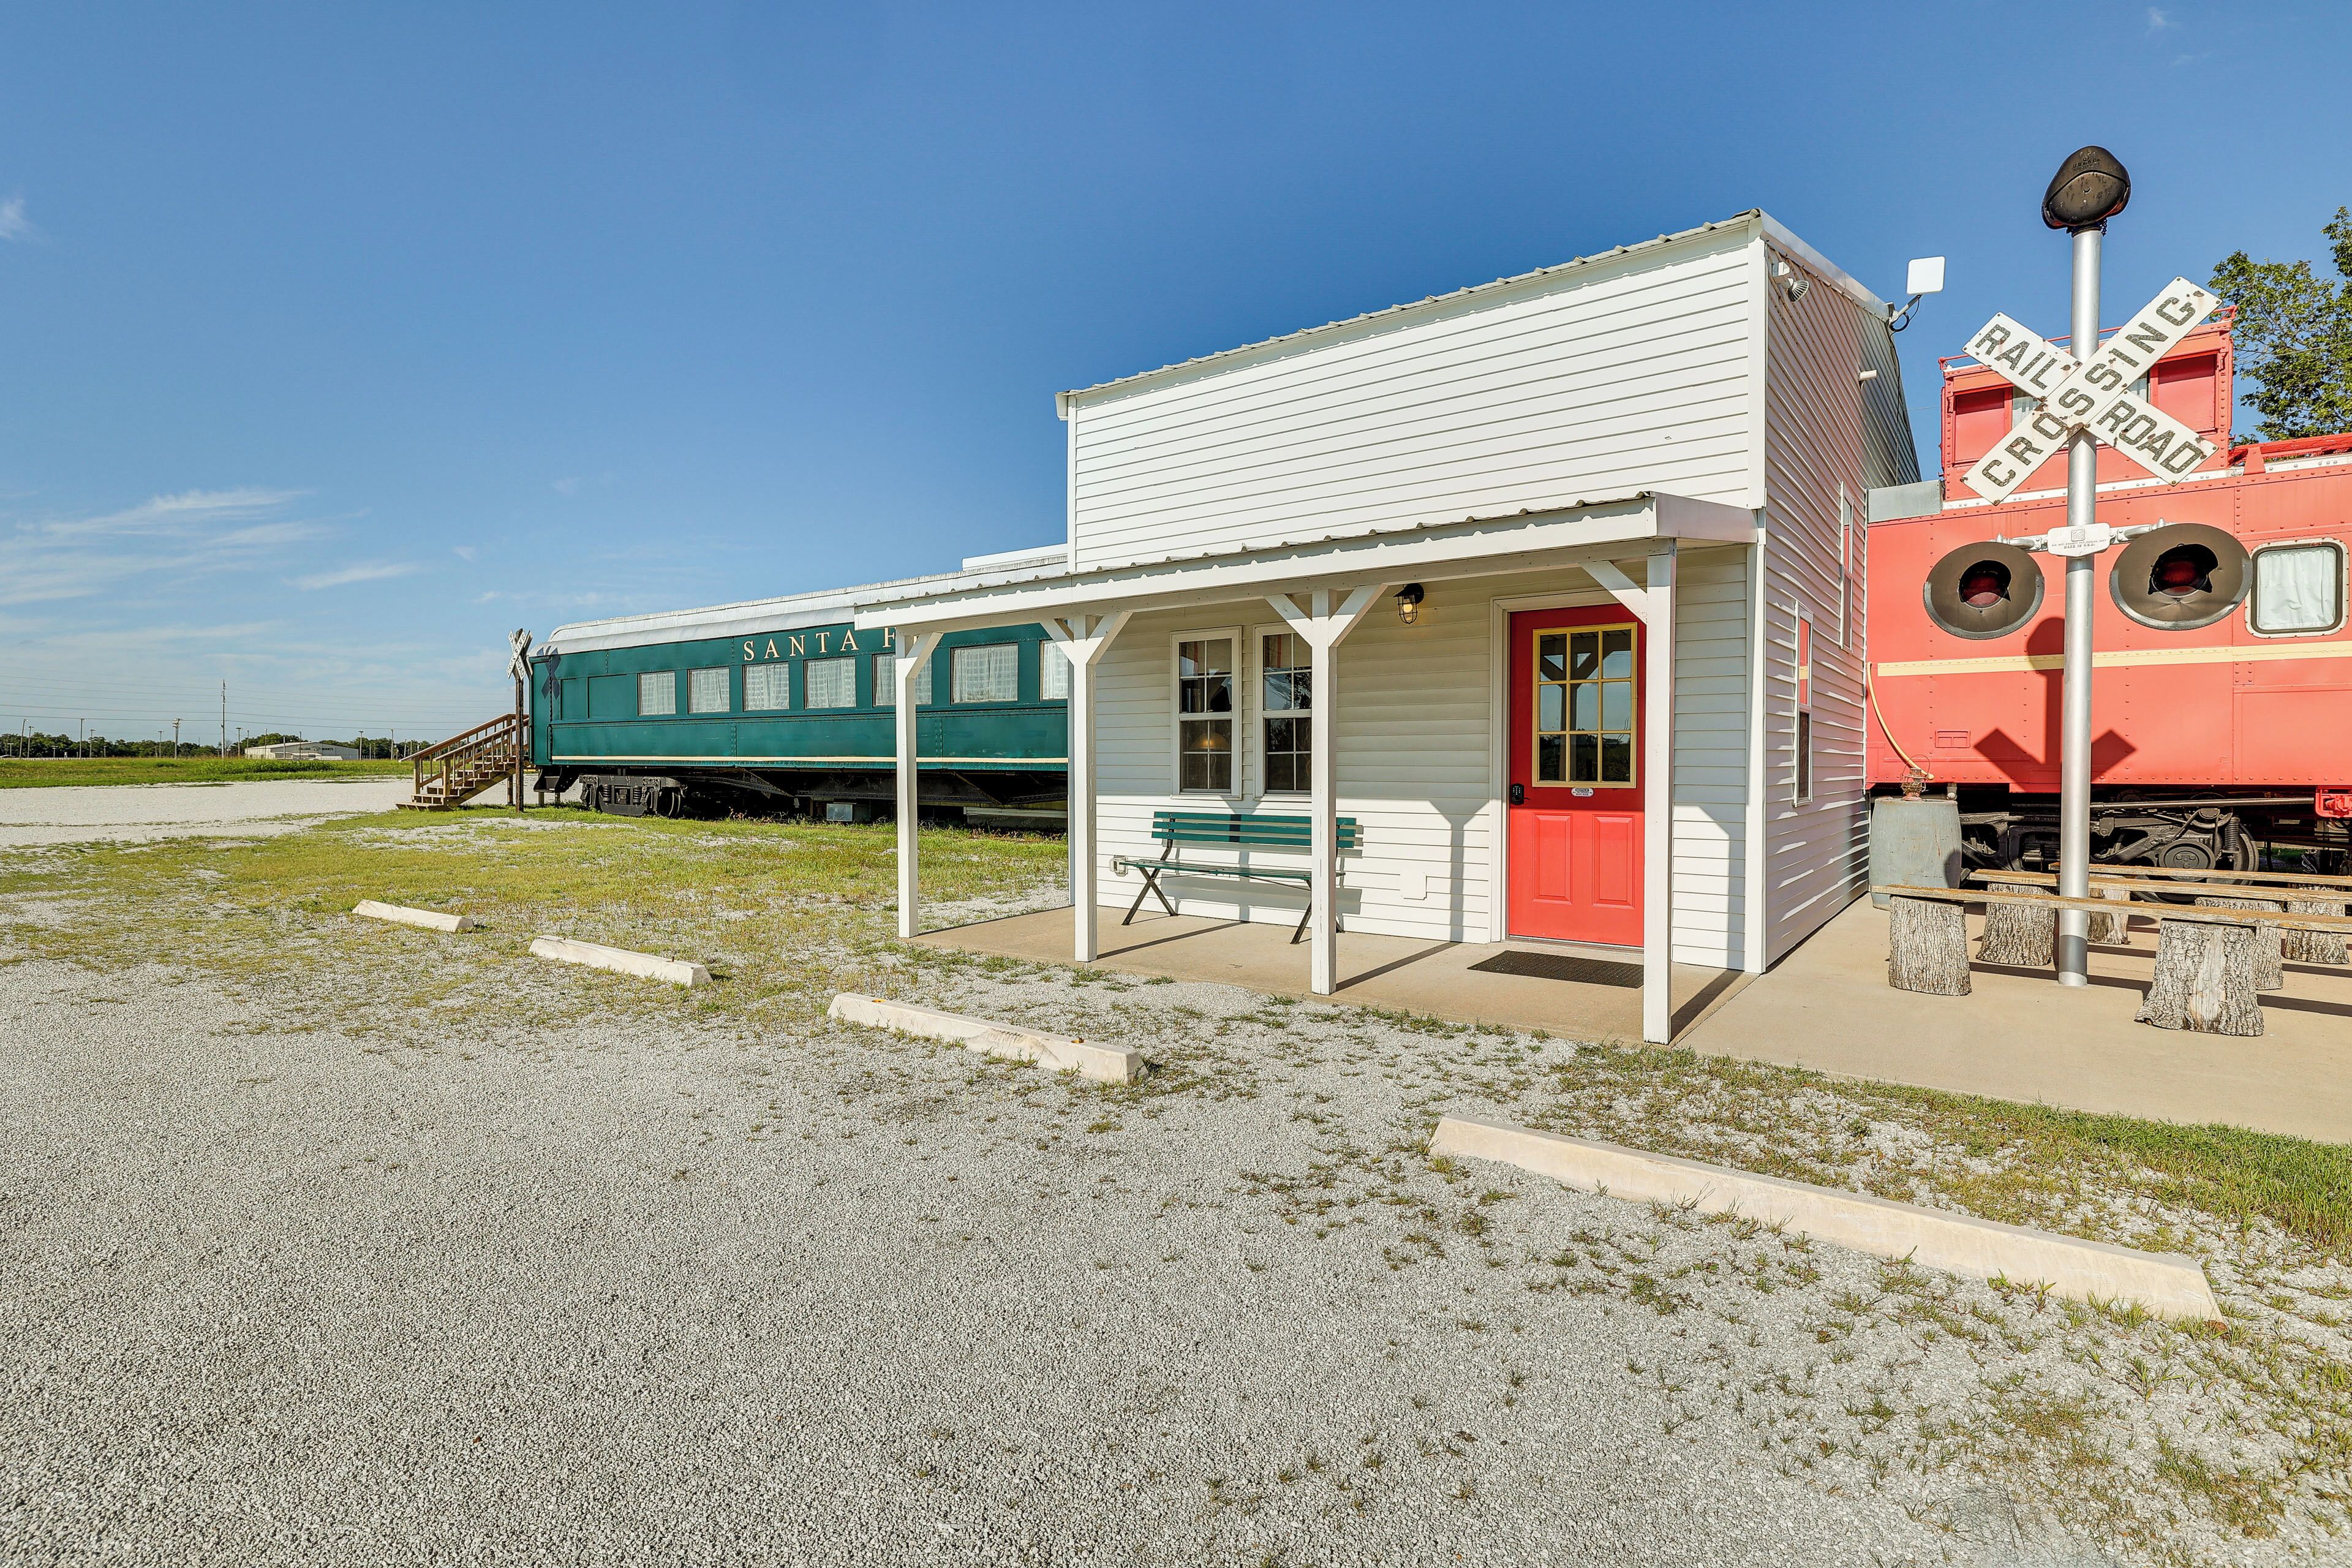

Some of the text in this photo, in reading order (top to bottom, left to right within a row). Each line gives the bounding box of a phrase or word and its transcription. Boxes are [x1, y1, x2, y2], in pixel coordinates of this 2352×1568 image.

[1973, 323, 2205, 474] RAIL ROAD
[1981, 296, 2196, 488] CROSSING
[743, 628, 859, 662] SANTA
